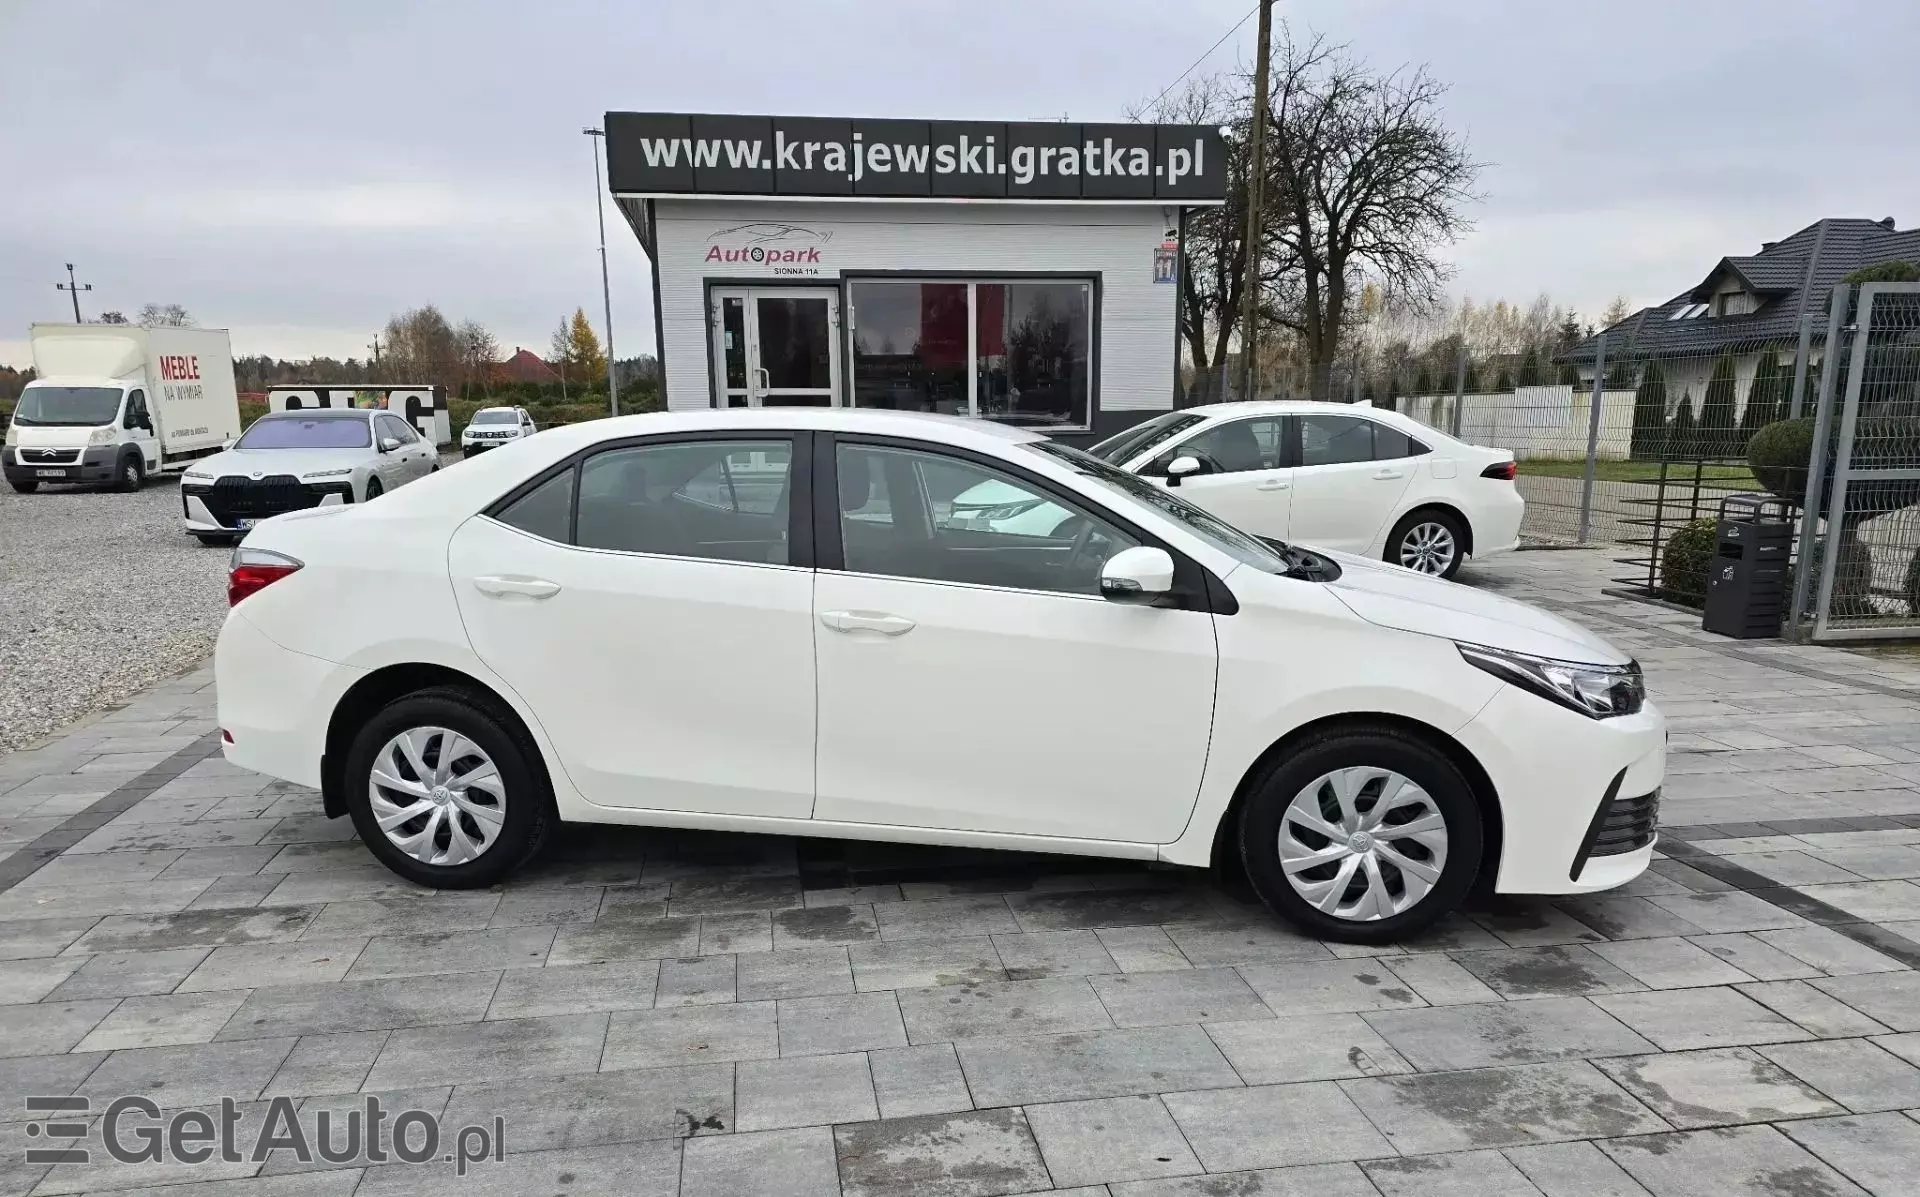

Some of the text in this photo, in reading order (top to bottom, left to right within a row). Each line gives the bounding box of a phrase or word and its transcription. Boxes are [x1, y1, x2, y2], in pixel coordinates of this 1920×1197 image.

[640, 131, 1205, 185] www.krajewski.gratka.pl
[705, 245, 822, 266] Autopark
[773, 267, 802, 275] SIONNA
[160, 355, 201, 381] MEBLE
